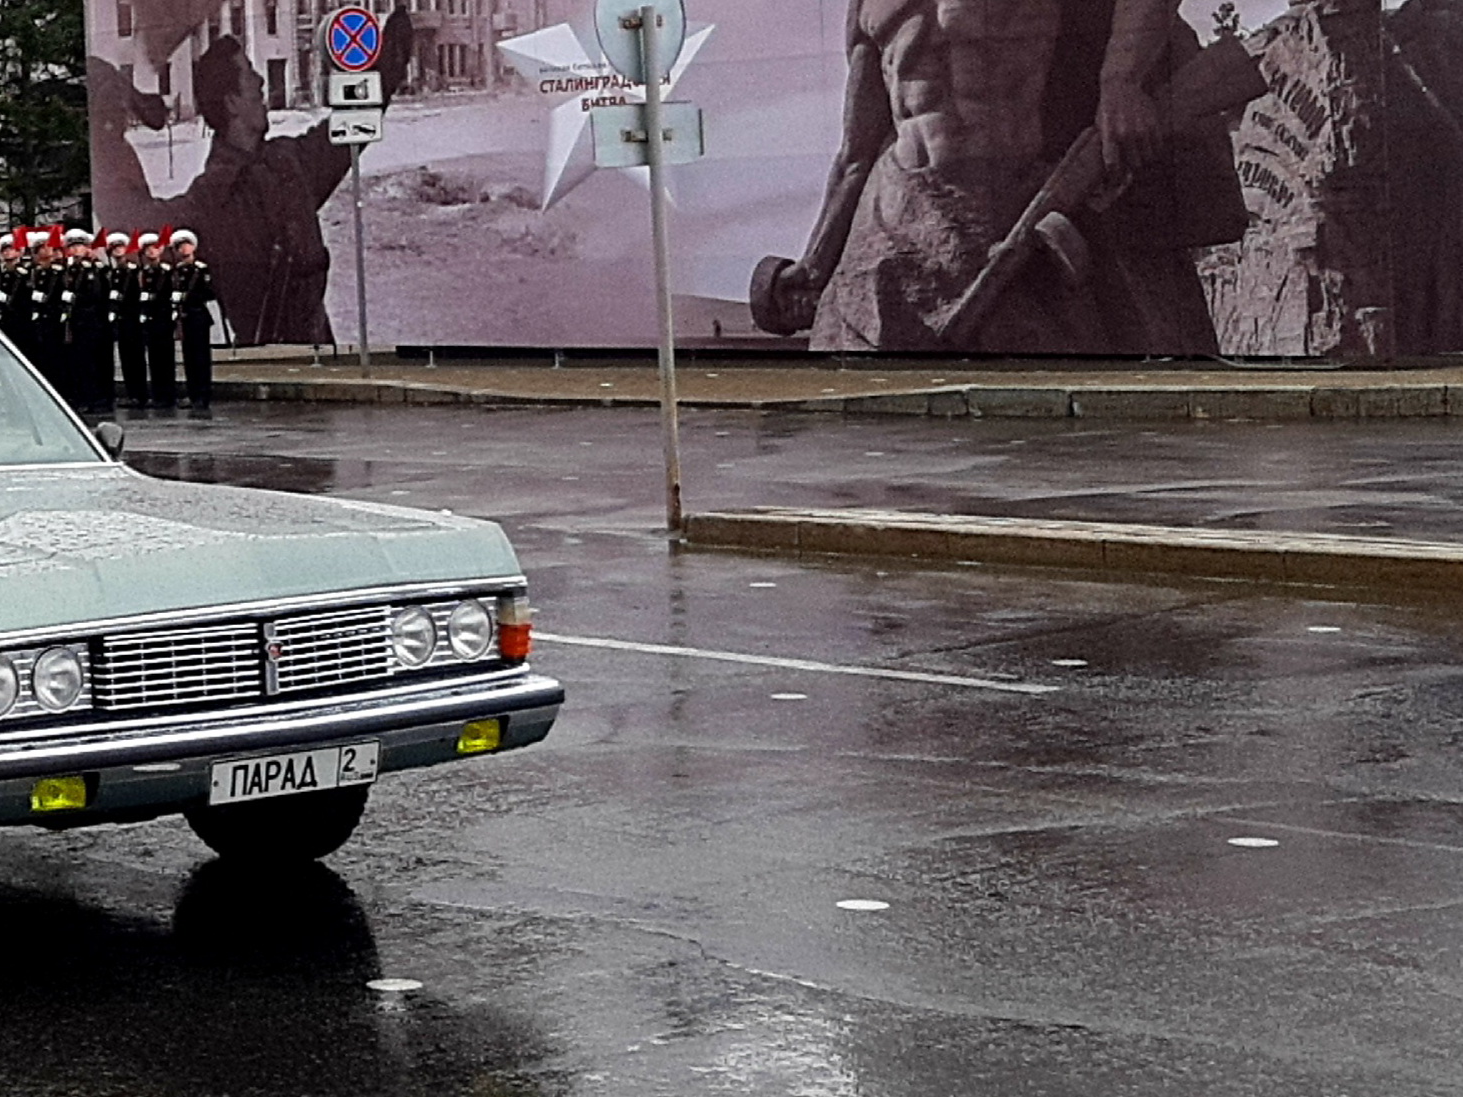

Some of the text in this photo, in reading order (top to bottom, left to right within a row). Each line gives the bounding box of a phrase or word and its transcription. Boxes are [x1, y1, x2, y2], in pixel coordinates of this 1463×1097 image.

[539, 71, 671, 94] СТАЛИНГРАДЯ
[230, 748, 357, 797] ПАРАД 2
